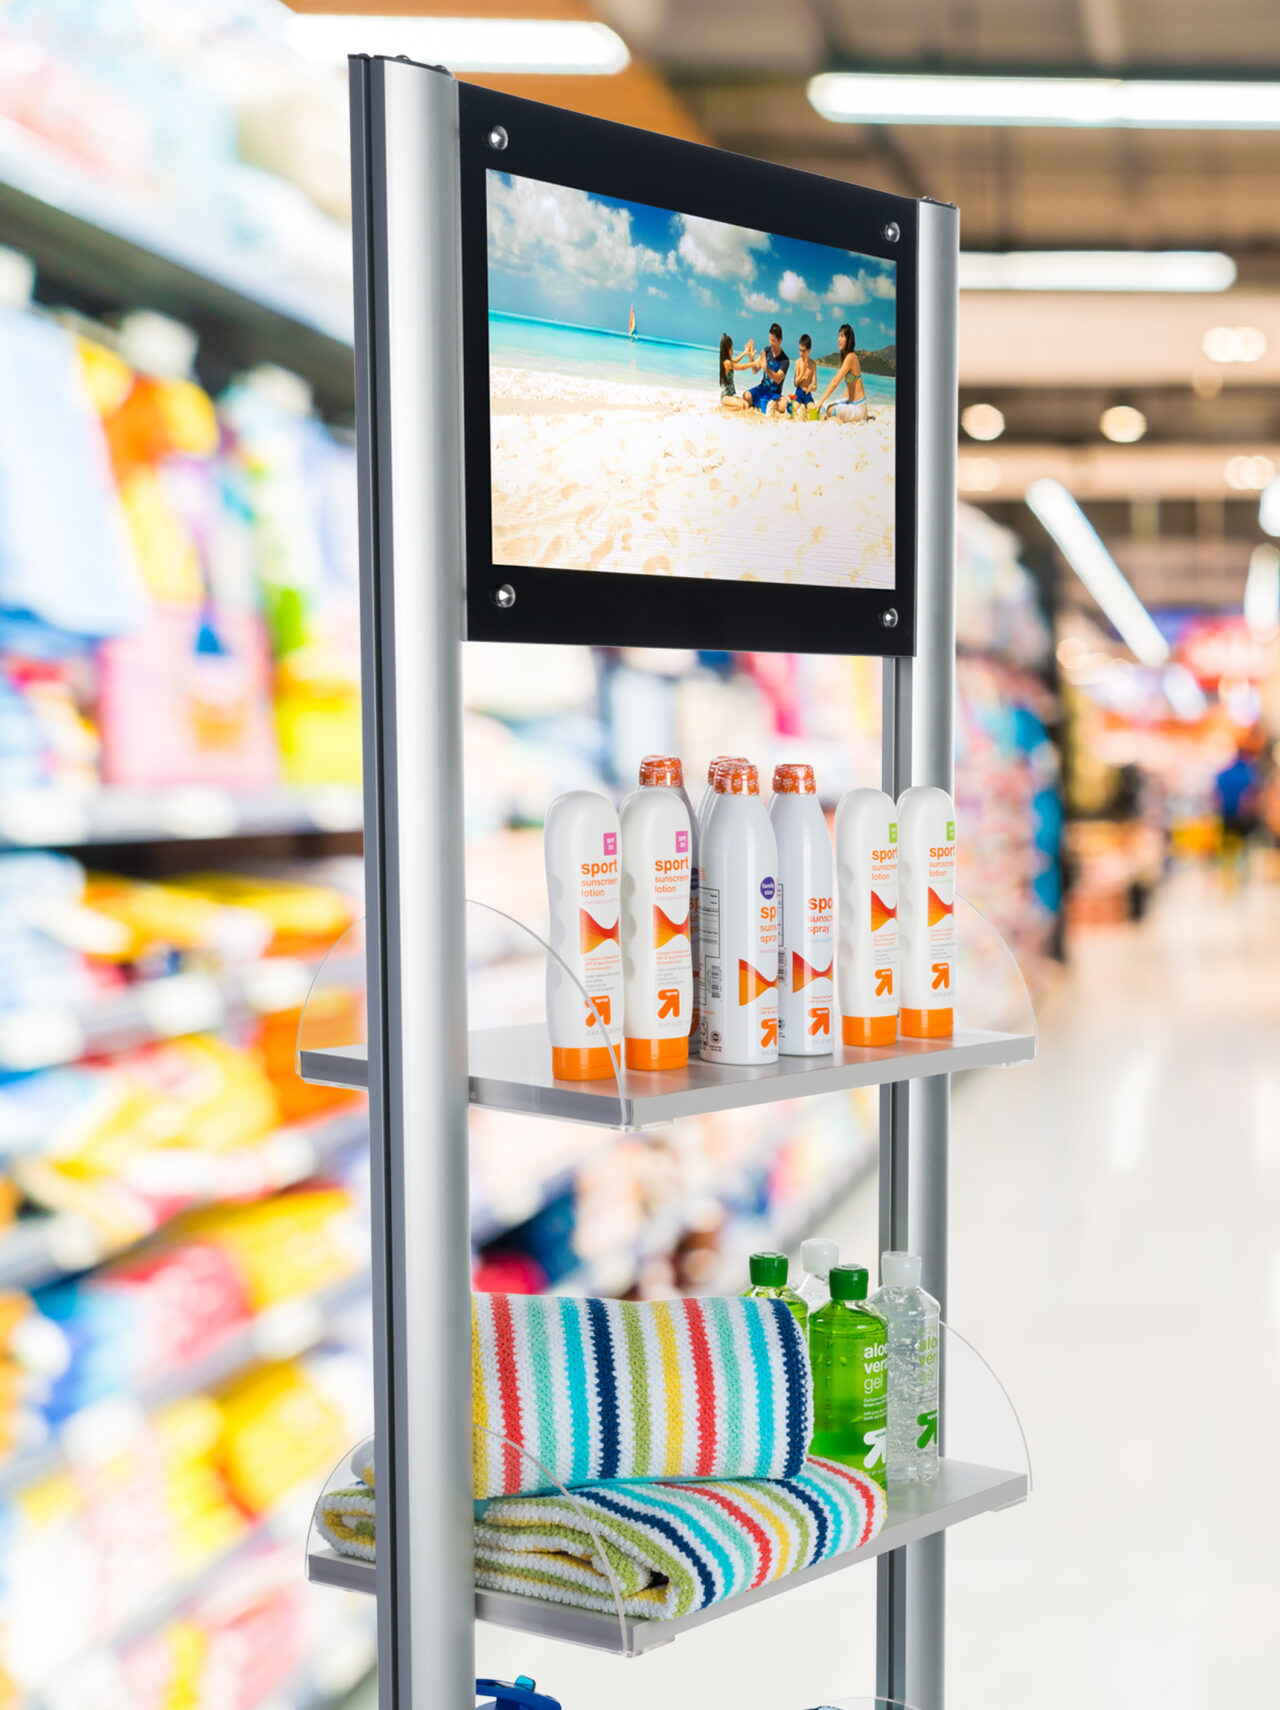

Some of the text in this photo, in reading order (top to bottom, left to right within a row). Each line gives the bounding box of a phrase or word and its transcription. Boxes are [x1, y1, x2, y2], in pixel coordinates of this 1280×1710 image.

[581, 858, 618, 878] sport
[655, 856, 689, 874] sport
[581, 888, 605, 897] lotion
[654, 885, 677, 894] lotion
[864, 1373, 883, 1394] gel
